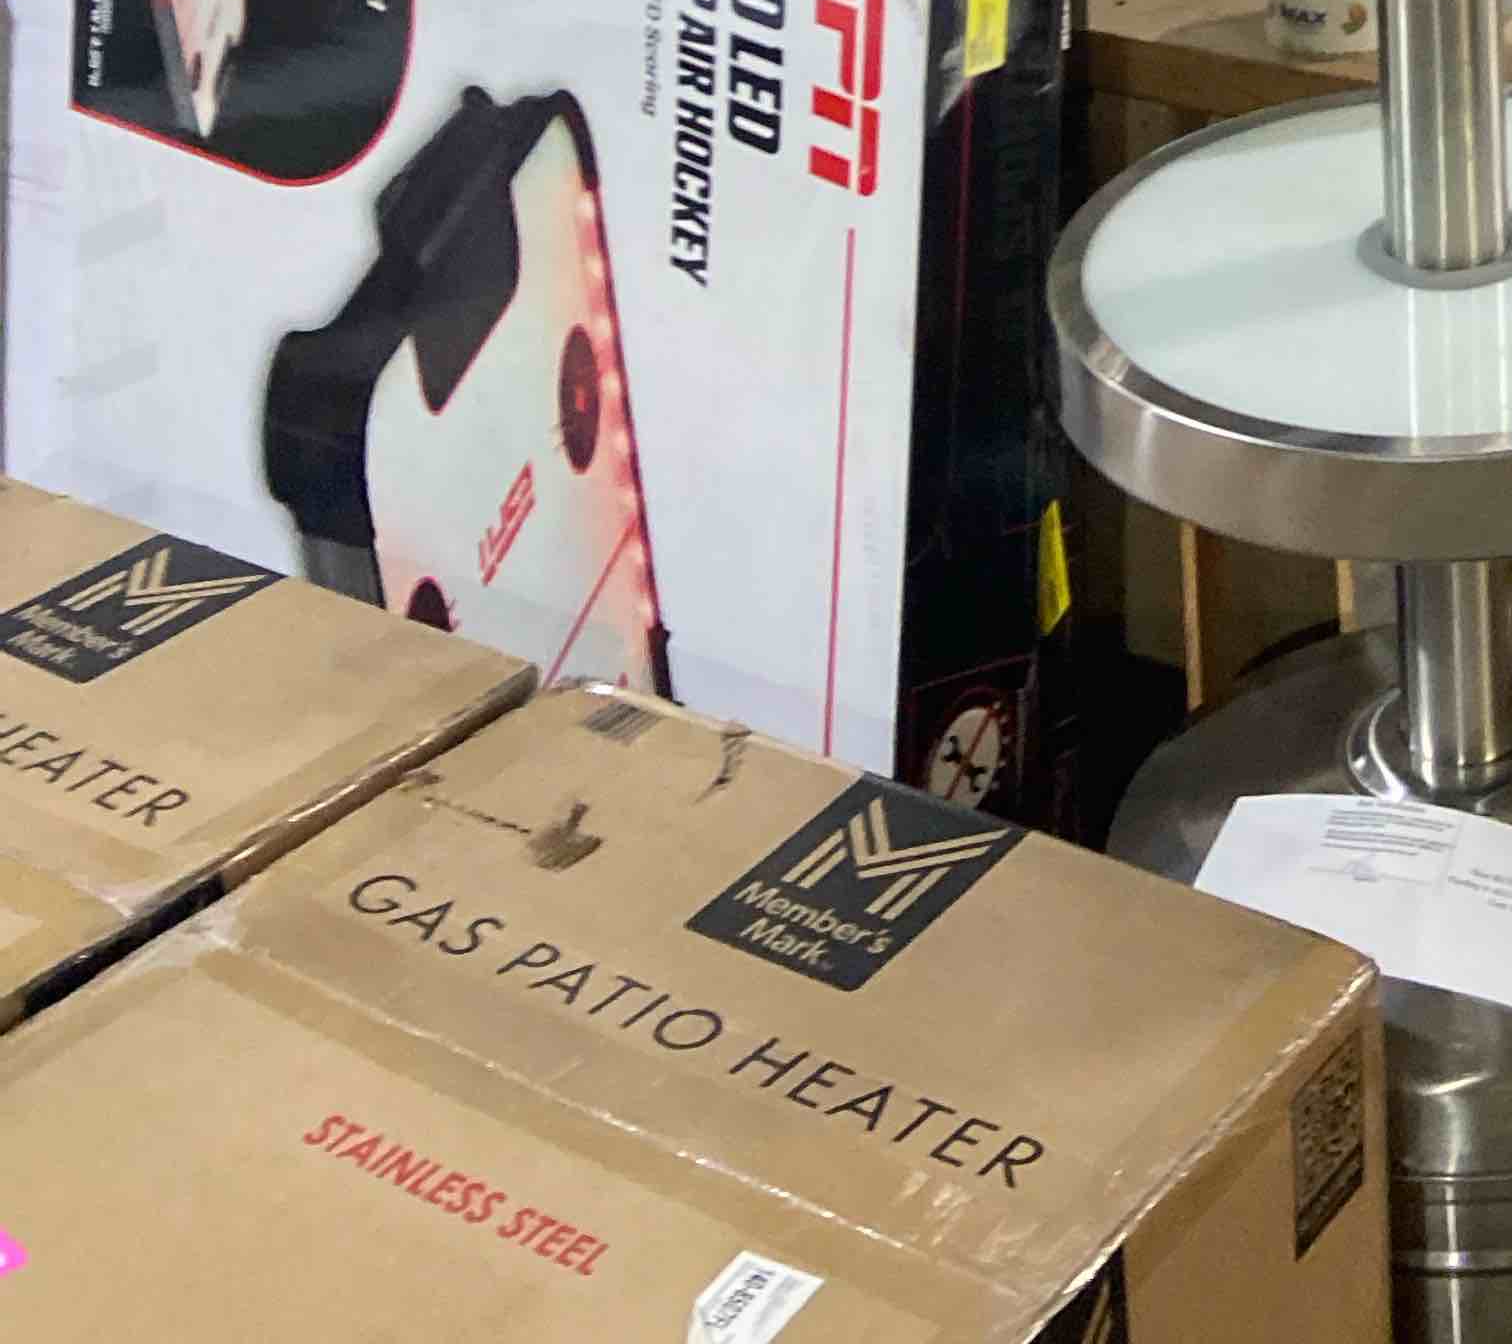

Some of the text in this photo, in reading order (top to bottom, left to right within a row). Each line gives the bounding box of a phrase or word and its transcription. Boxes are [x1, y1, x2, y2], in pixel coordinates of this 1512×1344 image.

[642, 26, 661, 118] Scoring
[675, 11, 717, 101] AIR
[728, 32, 785, 155] LED
[671, 103, 714, 287] HOCKEY
[5, 629, 78, 663] Mark
[10, 603, 138, 659] Member's
[733, 879, 893, 954] Member's
[739, 917, 829, 965] Mark
[349, 873, 1045, 1189] GAS PATIO HEATER
[302, 1114, 610, 1277] STAINLESS STEEL
